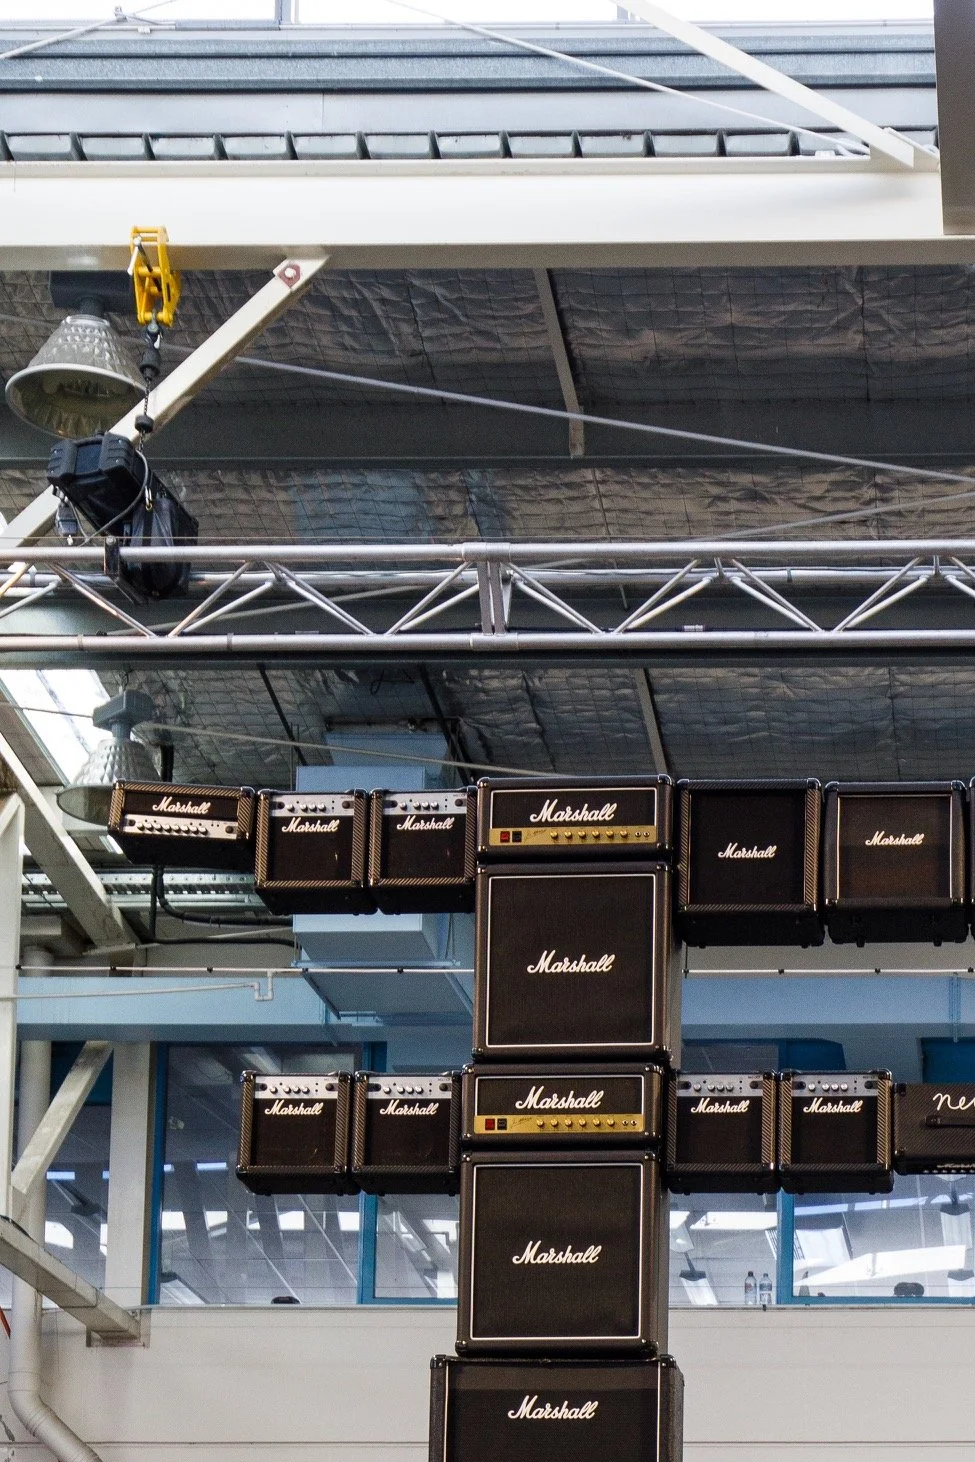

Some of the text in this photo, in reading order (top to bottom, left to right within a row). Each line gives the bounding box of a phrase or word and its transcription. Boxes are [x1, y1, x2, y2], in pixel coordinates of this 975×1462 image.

[151, 796, 211, 815] Marshall
[529, 798, 618, 823] Marshall
[281, 816, 341, 833] Marshall
[396, 814, 455, 831] Marshall
[864, 830, 925, 846] Marshall
[717, 842, 778, 859] Marshall
[526, 949, 616, 974] Marshall
[514, 1085, 605, 1110] Marshall
[690, 1097, 750, 1114] Marshall
[802, 1096, 864, 1114] Marshall
[264, 1099, 324, 1116] Marshall
[379, 1098, 440, 1116] Marshall
[511, 1240, 602, 1265] Marshall
[507, 1394, 599, 1420] Marshall
